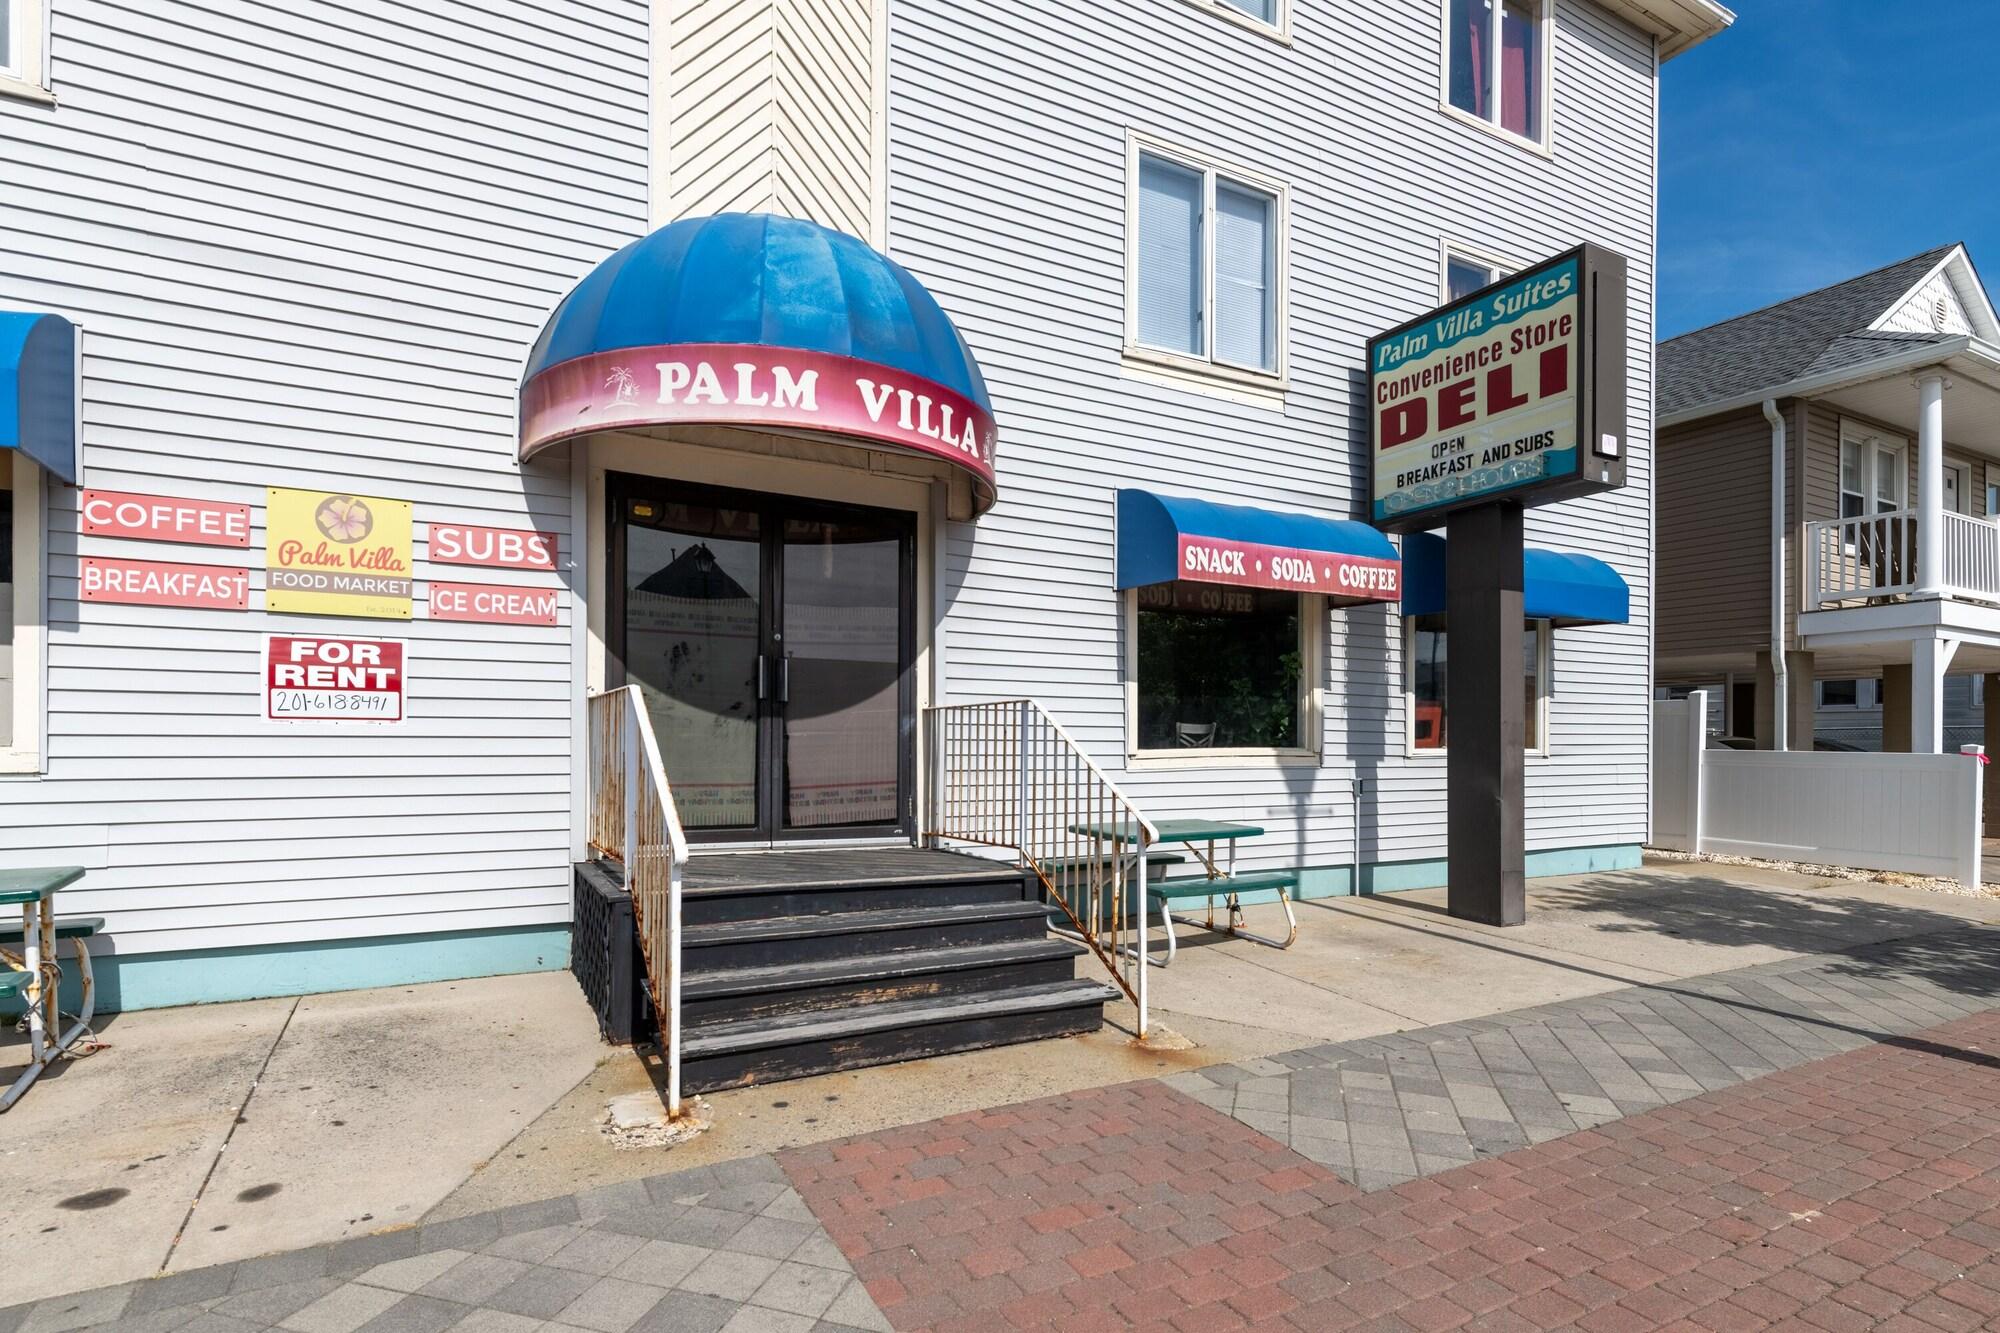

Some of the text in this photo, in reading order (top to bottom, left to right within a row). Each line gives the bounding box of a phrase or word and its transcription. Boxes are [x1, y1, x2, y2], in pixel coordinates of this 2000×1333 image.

[1378, 271, 1572, 368] Palm Villa Suites
[1377, 313, 1573, 405] Convenience Store
[655, 362, 979, 459] PALM VILLA
[1380, 343, 1568, 450] DELI
[1396, 430, 1555, 489] BREAKFAST AND SUBS
[1431, 436, 1465, 459] OPEN
[84, 499, 247, 537] COFFEE
[278, 539, 406, 572] Palm Villa
[436, 528, 551, 565] SUBS
[84, 567, 248, 600] BREAKFAST
[272, 572, 410, 595] FOOD MARKET
[1184, 545, 1397, 592] SNACK SODA COFFEE
[430, 589, 556, 617] ICE CREAM
[290, 640, 382, 665] FOR
[274, 663, 397, 689] RENT
